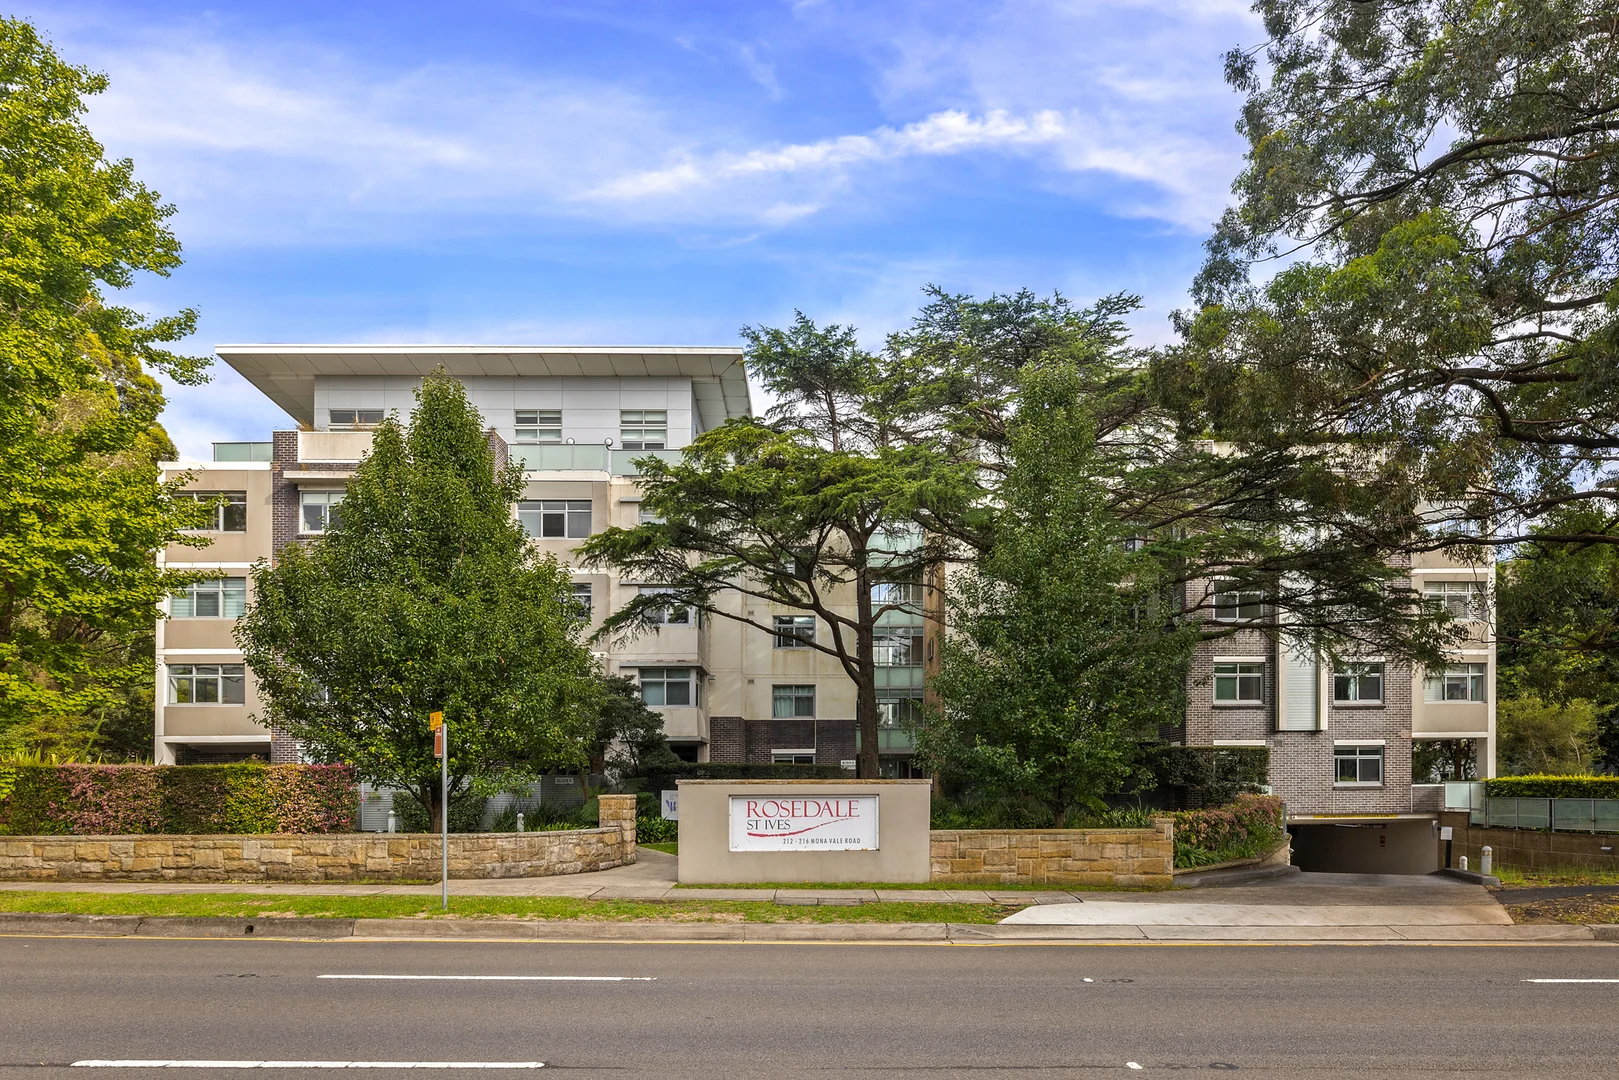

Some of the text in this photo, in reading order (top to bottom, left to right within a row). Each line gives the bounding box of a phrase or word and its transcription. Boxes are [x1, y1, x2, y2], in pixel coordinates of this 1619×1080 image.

[747, 800, 860, 818] ROSEDALE
[747, 820, 791, 830] ST IVES
